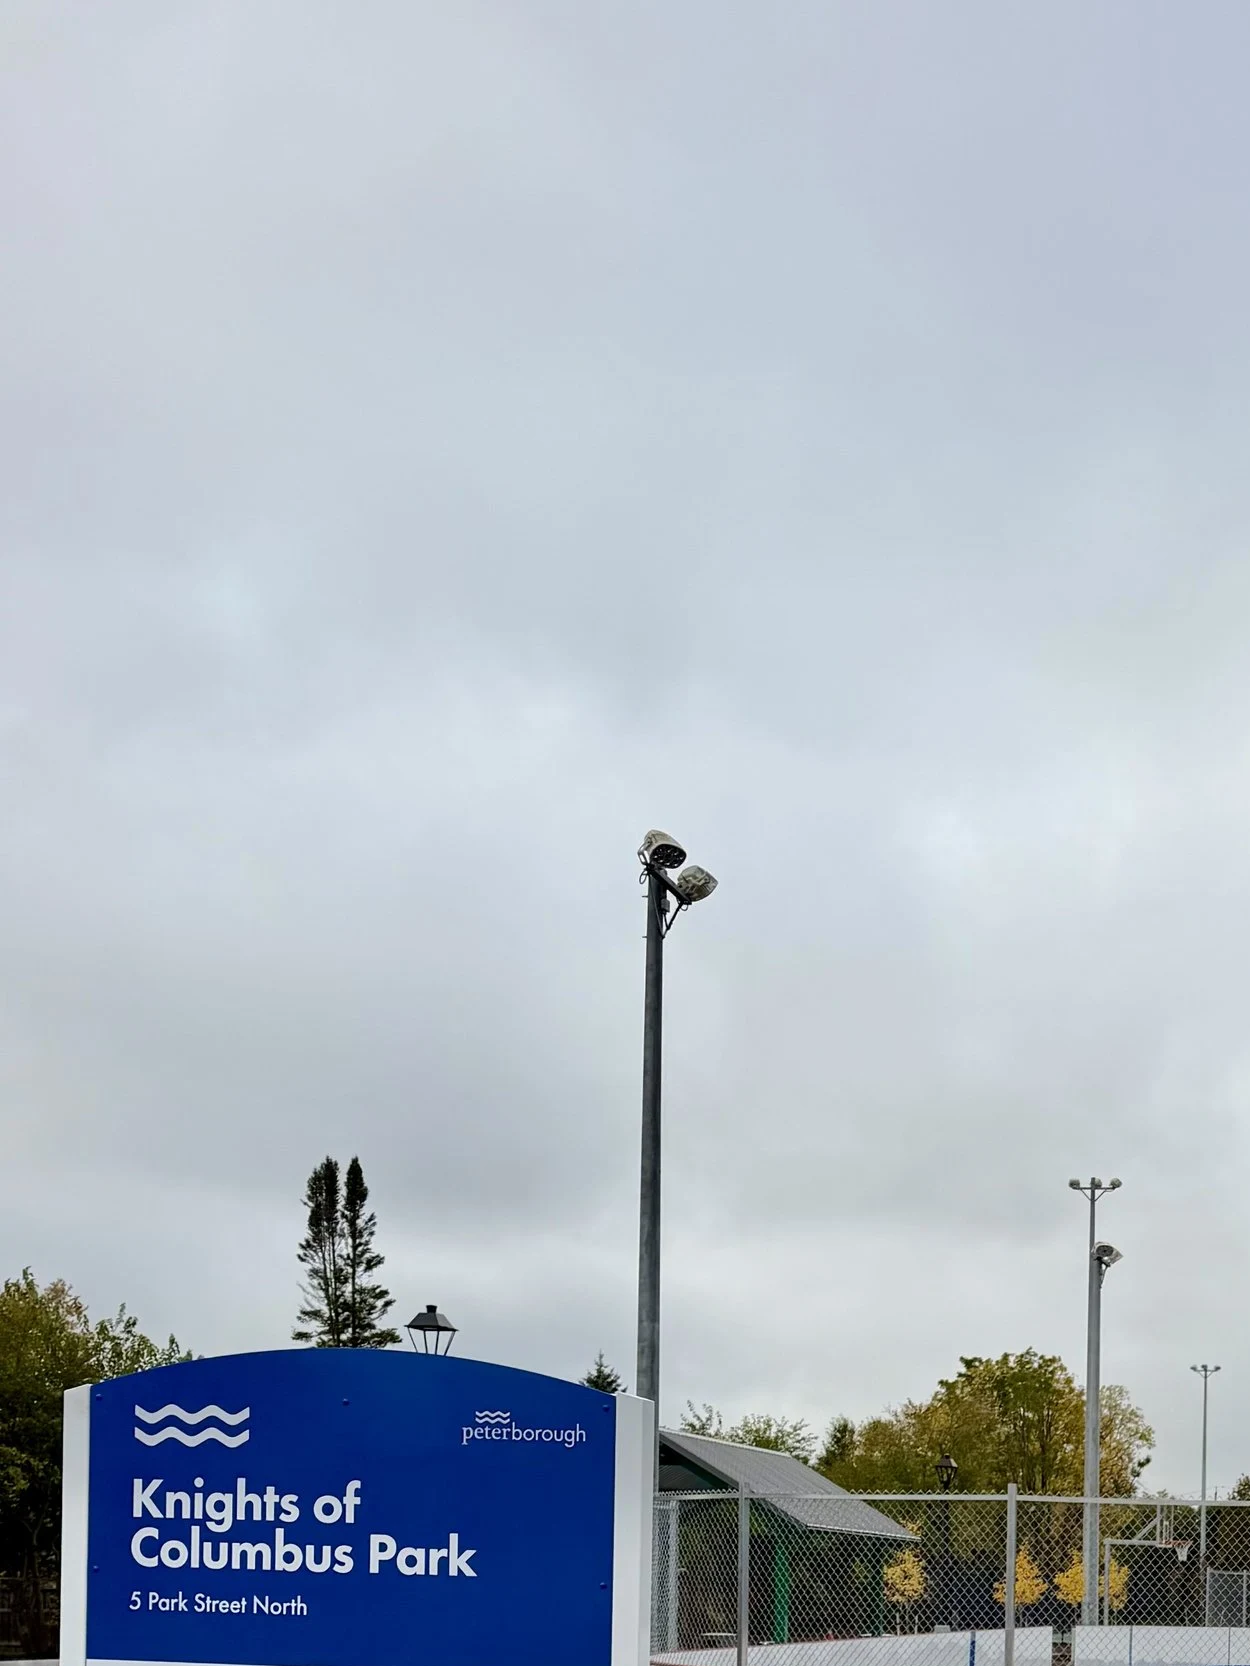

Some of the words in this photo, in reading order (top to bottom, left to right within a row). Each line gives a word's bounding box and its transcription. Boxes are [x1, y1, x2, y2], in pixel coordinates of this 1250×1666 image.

[462, 1421, 586, 1448] peterborough
[133, 1477, 299, 1533] Knights
[313, 1480, 361, 1524] of
[130, 1526, 354, 1574] Columbus
[369, 1533, 477, 1577] Park
[129, 1592, 141, 1610] 5
[148, 1592, 189, 1612] Park
[194, 1593, 247, 1614] Street
[253, 1595, 308, 1616] North
